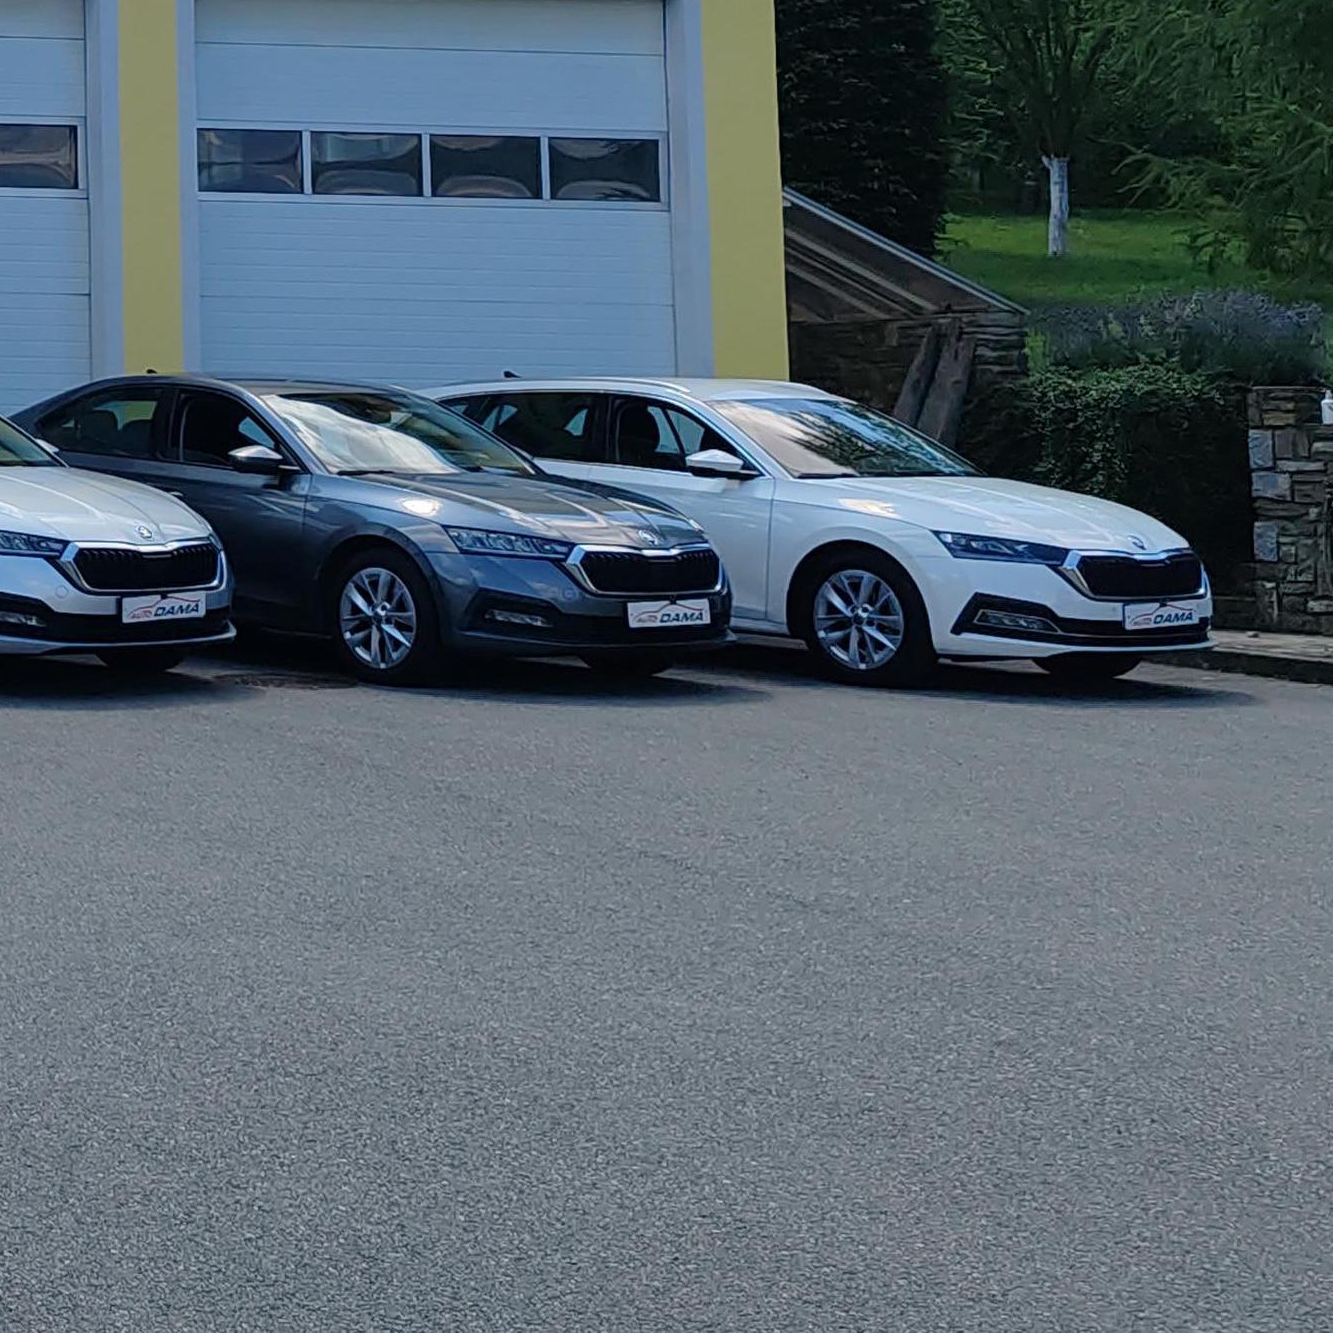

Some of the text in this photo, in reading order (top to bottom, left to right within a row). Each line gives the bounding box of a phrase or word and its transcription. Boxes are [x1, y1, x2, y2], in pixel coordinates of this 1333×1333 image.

[153, 603, 200, 617] DAMA
[659, 612, 704, 623] DAMA
[1153, 612, 1194, 624] DAMA
